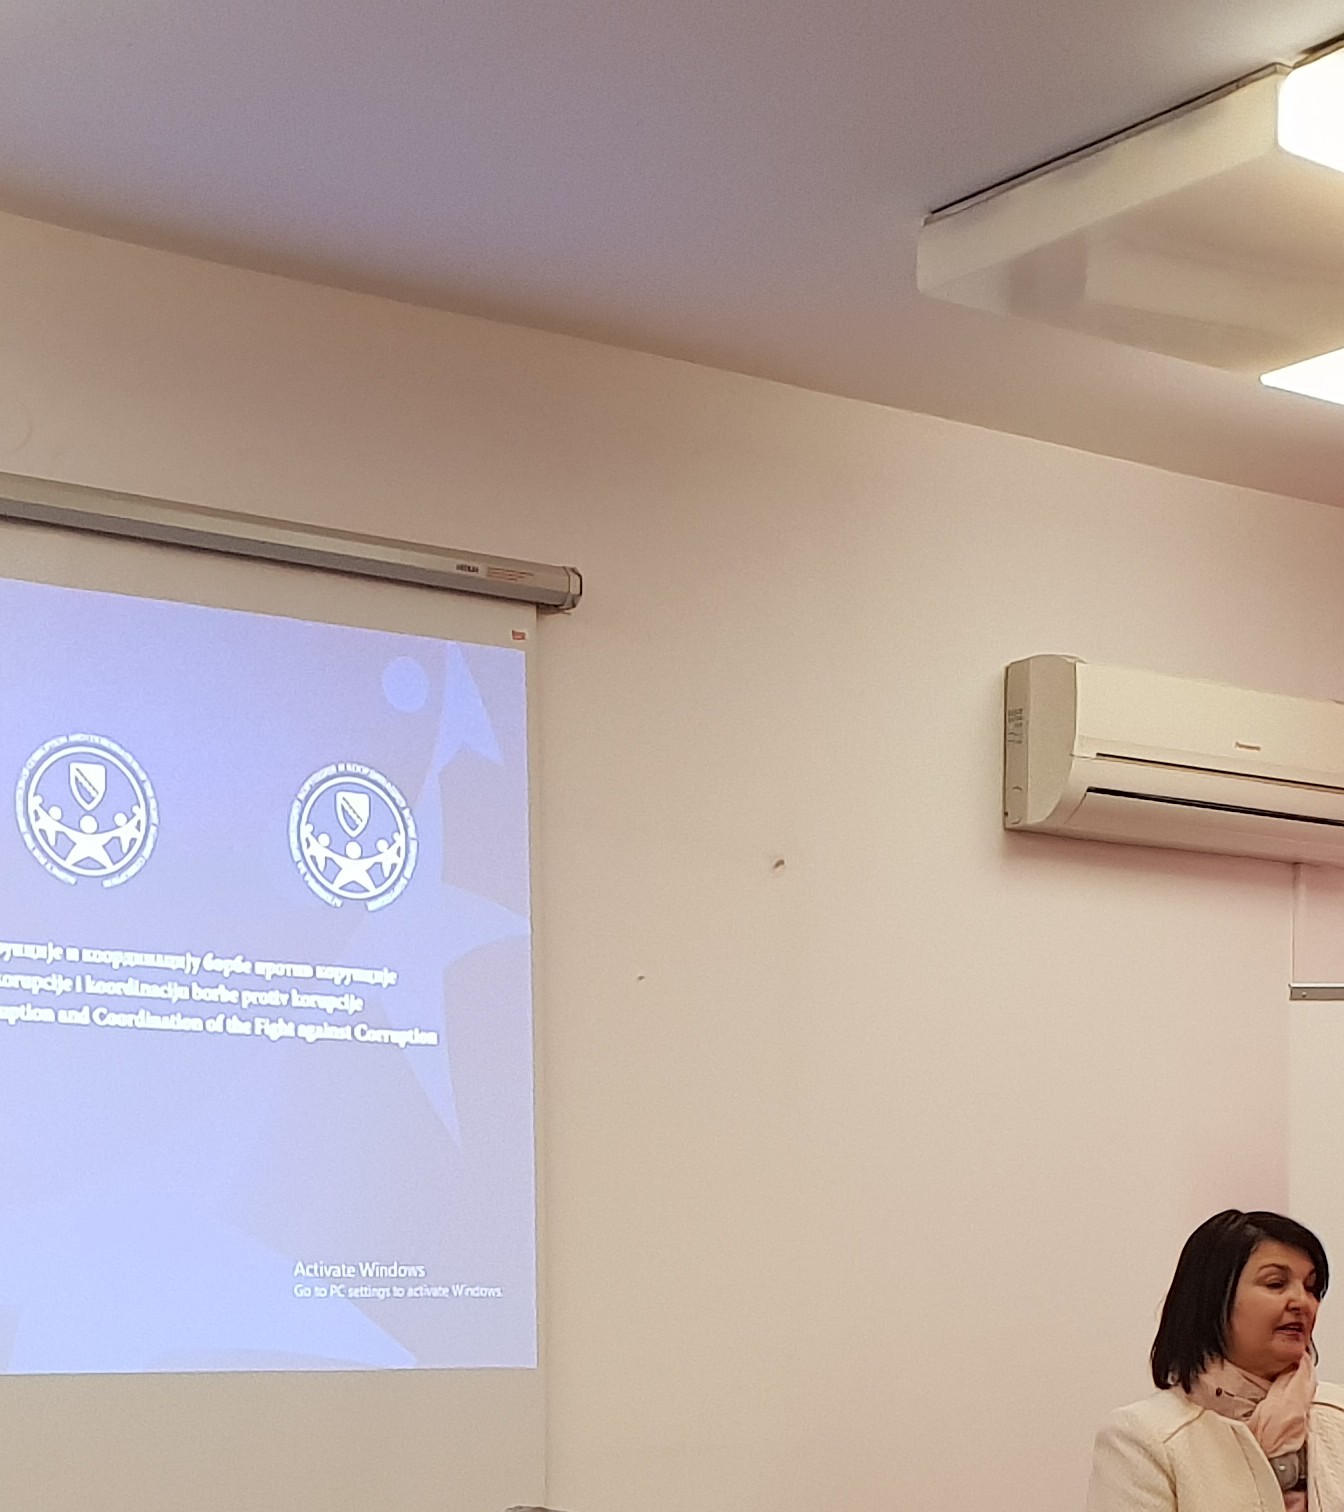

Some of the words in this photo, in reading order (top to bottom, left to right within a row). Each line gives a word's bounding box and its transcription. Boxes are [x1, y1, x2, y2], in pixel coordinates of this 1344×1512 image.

[75, 975, 82, 992] i
[85, 975, 190, 1003] koordinaciju
[191, 982, 239, 1002] borbe
[241, 986, 290, 1009] protiv
[291, 988, 364, 1014] korupcije
[58, 1005, 90, 1025] and
[92, 1007, 203, 1032] Coordination
[205, 1014, 225, 1033] of
[226, 1016, 252, 1035] the
[255, 1017, 296, 1041] Fight
[297, 1023, 352, 1043] against
[354, 1023, 439, 1048] Corruption
[294, 1261, 356, 1278] Activate
[358, 1261, 426, 1278] Windows
[294, 1284, 311, 1297] Go
[314, 1284, 327, 1297] to
[329, 1284, 346, 1298] PC
[347, 1284, 391, 1300] settings
[392, 1285, 405, 1298] to
[406, 1285, 449, 1298] activate
